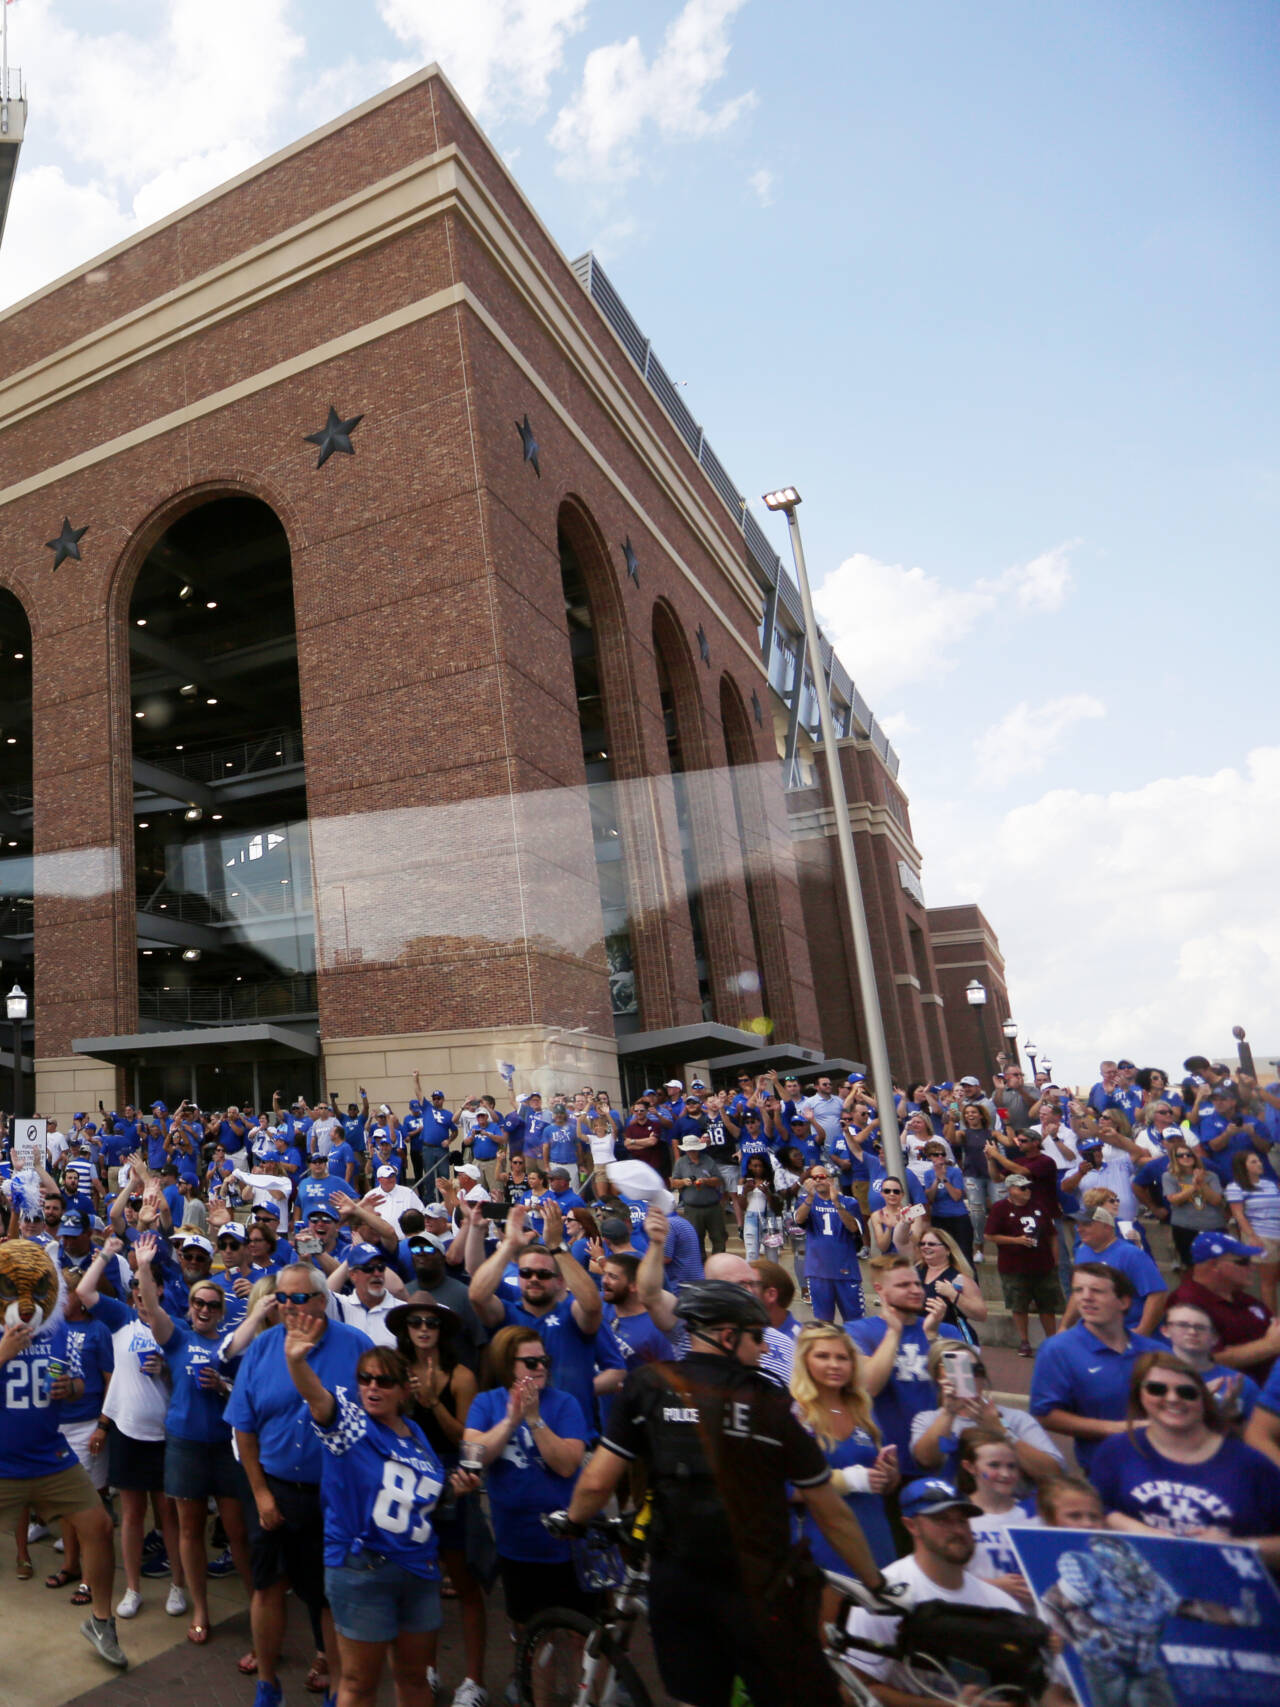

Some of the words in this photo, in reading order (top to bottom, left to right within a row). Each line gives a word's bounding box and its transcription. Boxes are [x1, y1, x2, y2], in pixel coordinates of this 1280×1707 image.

[257, 1136, 266, 1151] 7
[709, 1127, 725, 1145] 18
[822, 1213, 833, 1236] 1
[1020, 1216, 1036, 1233] 2
[16, 1343, 52, 1356] NTUCKY
[662, 1407, 700, 1423] POLICE
[1129, 1479, 1233, 1519] KENTUCKY
